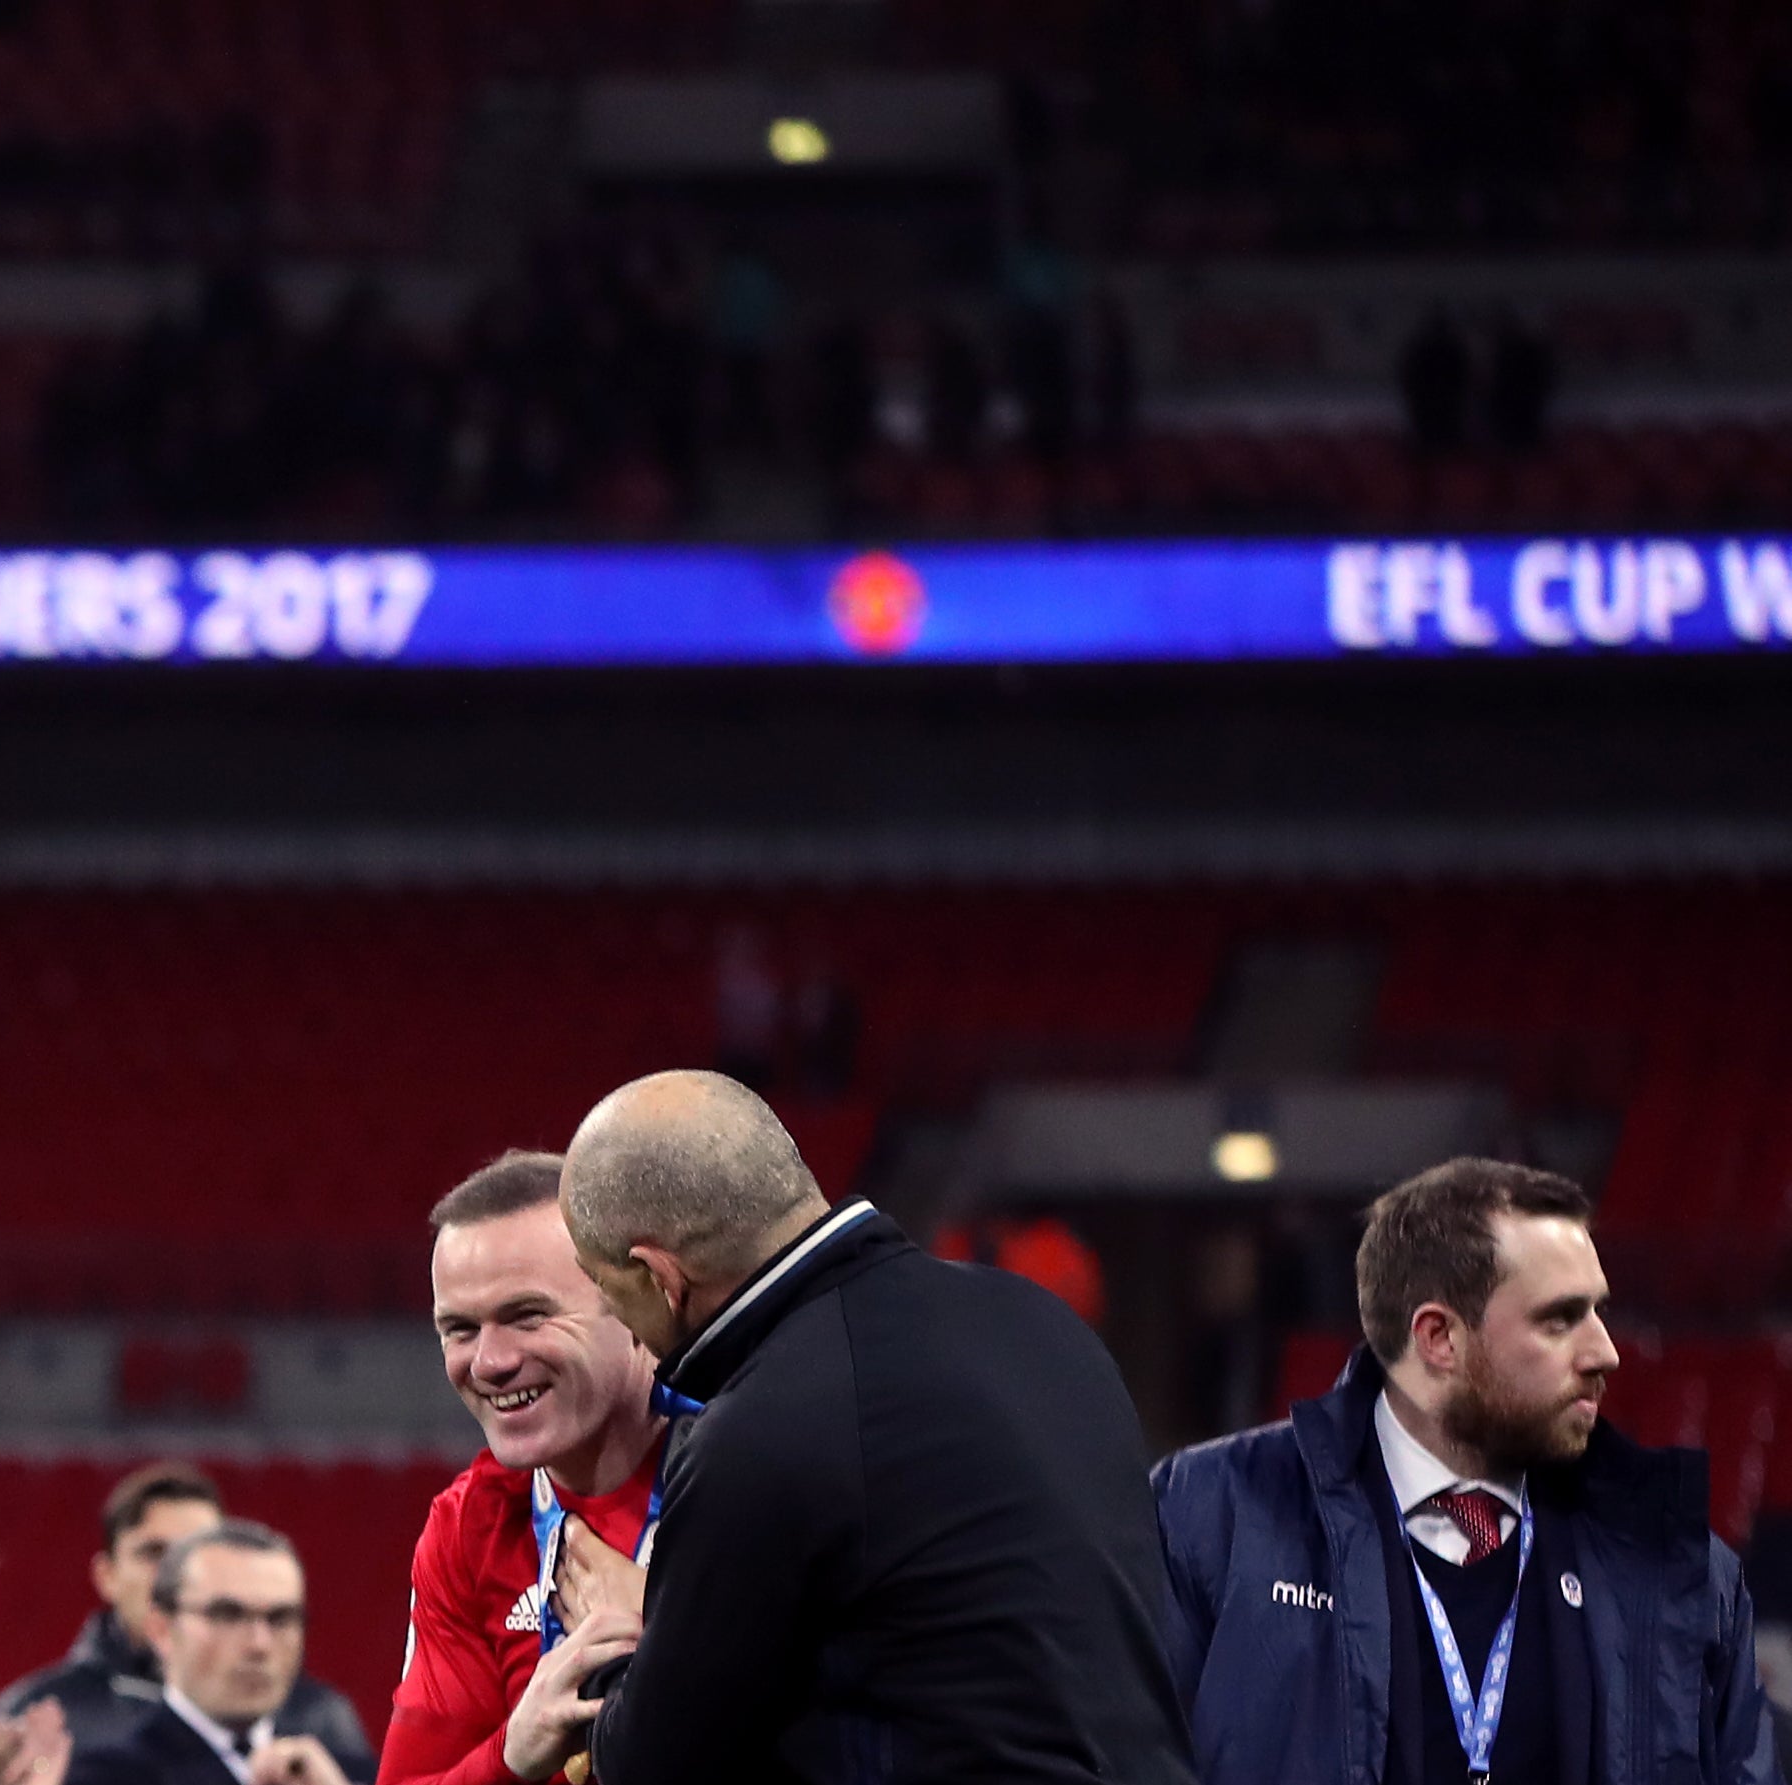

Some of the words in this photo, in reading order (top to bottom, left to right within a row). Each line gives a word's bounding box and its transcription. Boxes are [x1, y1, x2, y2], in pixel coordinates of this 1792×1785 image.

[190, 548, 433, 662] 2017
[1325, 540, 1501, 650] EFL
[1510, 539, 1708, 649] CUP
